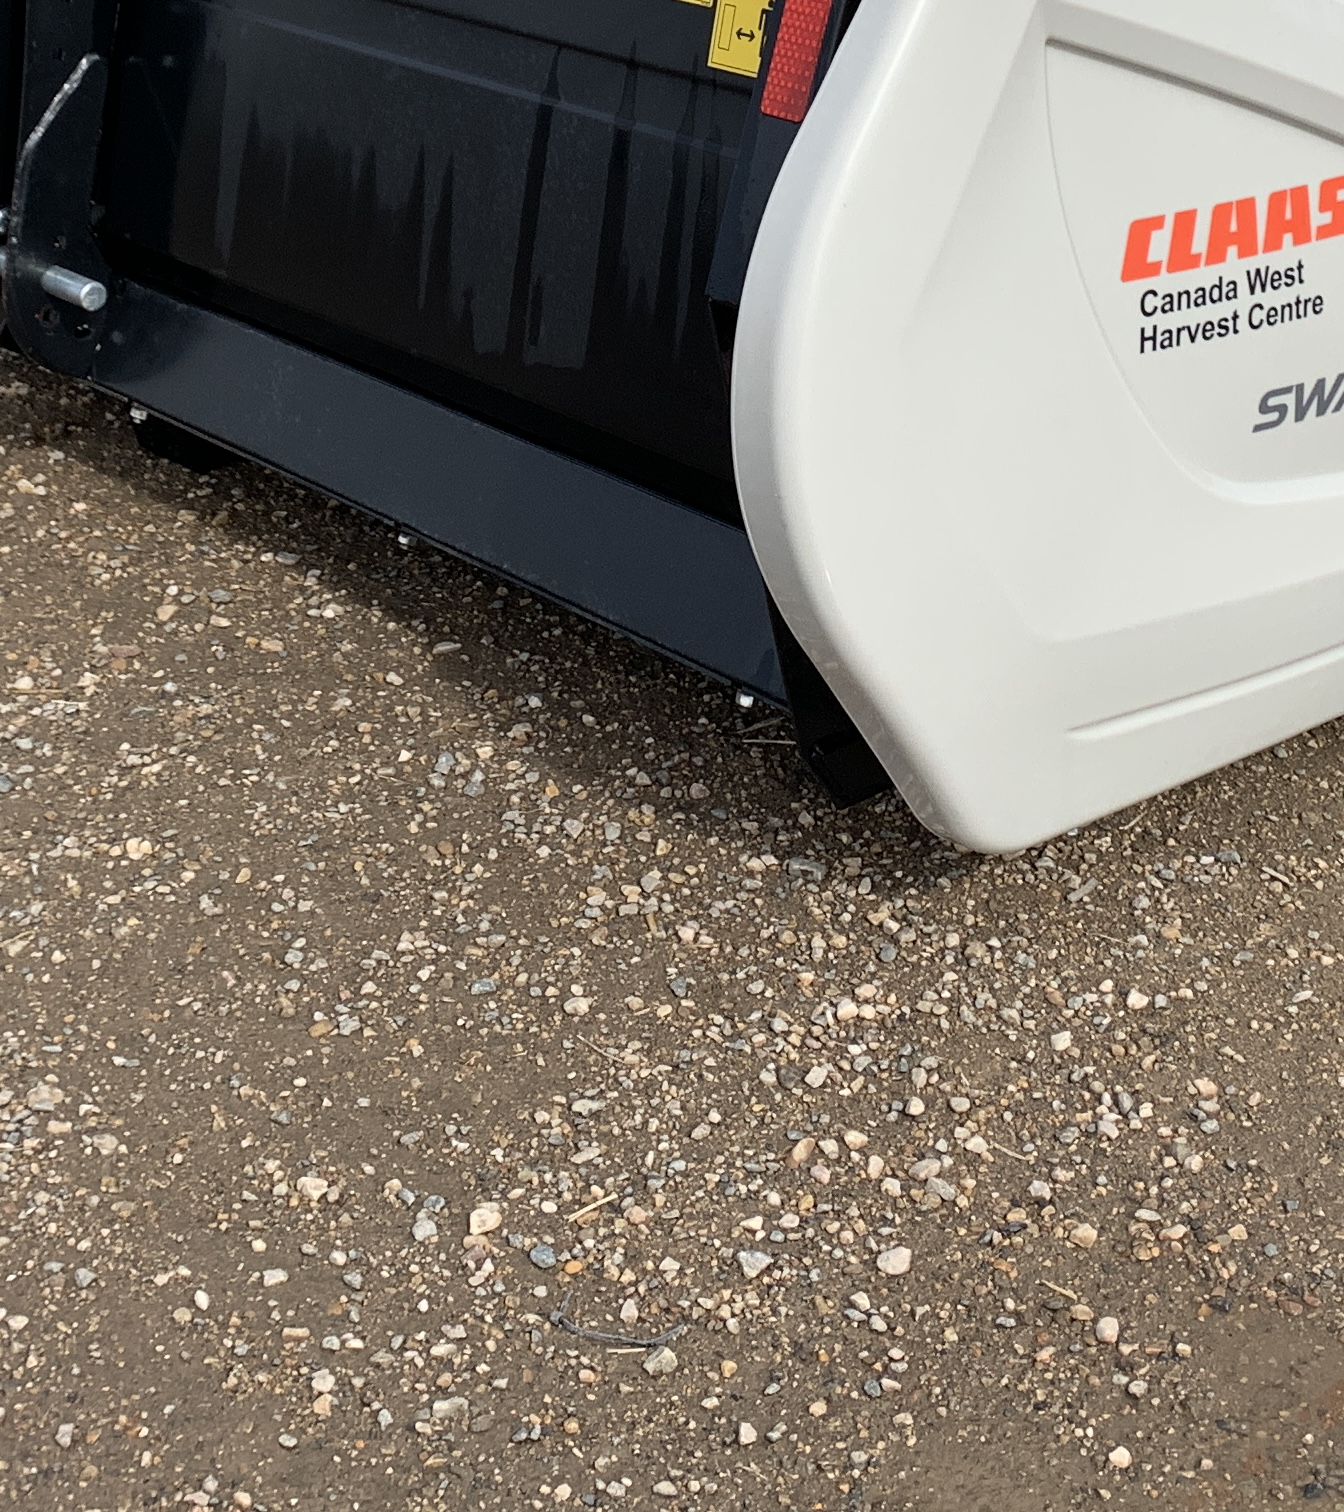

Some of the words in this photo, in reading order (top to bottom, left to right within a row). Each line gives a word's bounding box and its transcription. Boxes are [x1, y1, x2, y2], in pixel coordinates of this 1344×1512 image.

[1140, 276, 1238, 317] Canada
[1246, 259, 1305, 296] West
[1139, 309, 1240, 354] Harvest
[1247, 294, 1324, 330] Centre
